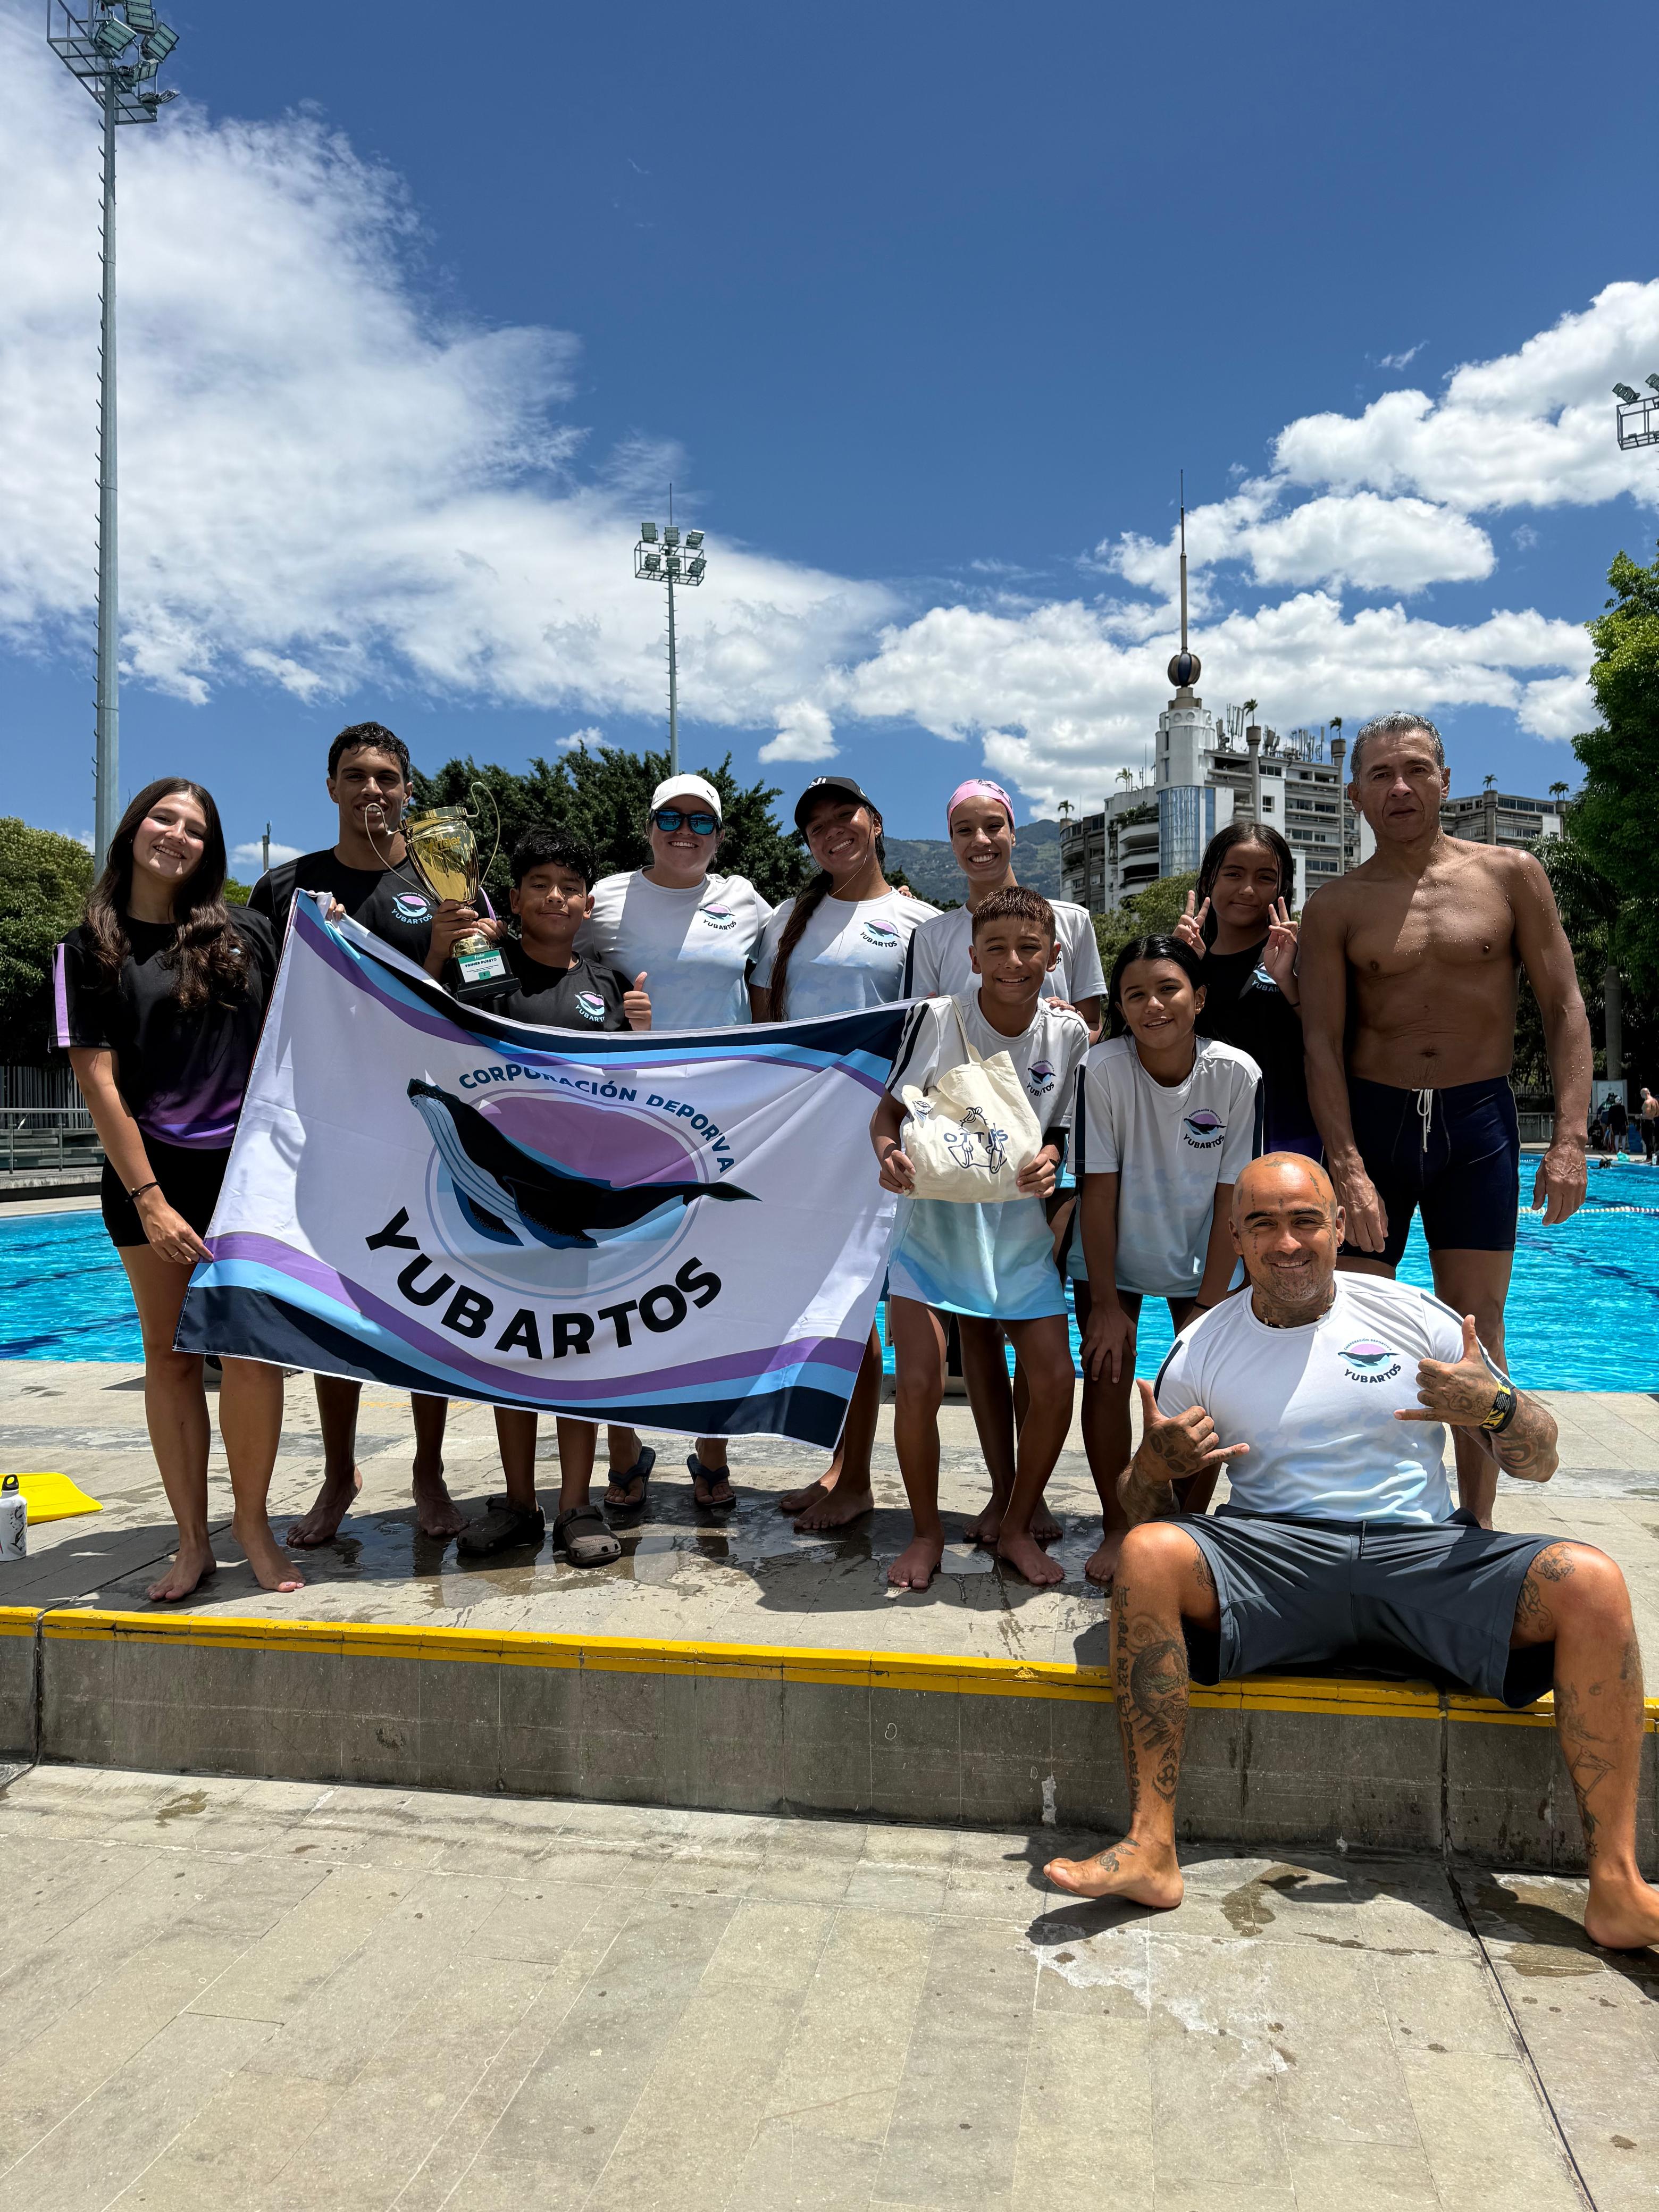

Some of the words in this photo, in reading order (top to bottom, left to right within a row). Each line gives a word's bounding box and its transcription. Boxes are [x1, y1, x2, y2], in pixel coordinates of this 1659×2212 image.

[391, 908, 433, 924] YUBARTOS
[703, 920, 736, 930] YUBARTOS
[860, 932, 898, 948] YUBARTOS
[1252, 980, 1279, 992] YUBAR
[575, 1004, 605, 1022] YUBART
[1027, 1082, 1054, 1097] YUBTOS
[1183, 1133, 1225, 1149] YUBARTOS
[365, 1206, 722, 1360] YUBARTOS
[1344, 1363, 1401, 1383] YUBARTOS
